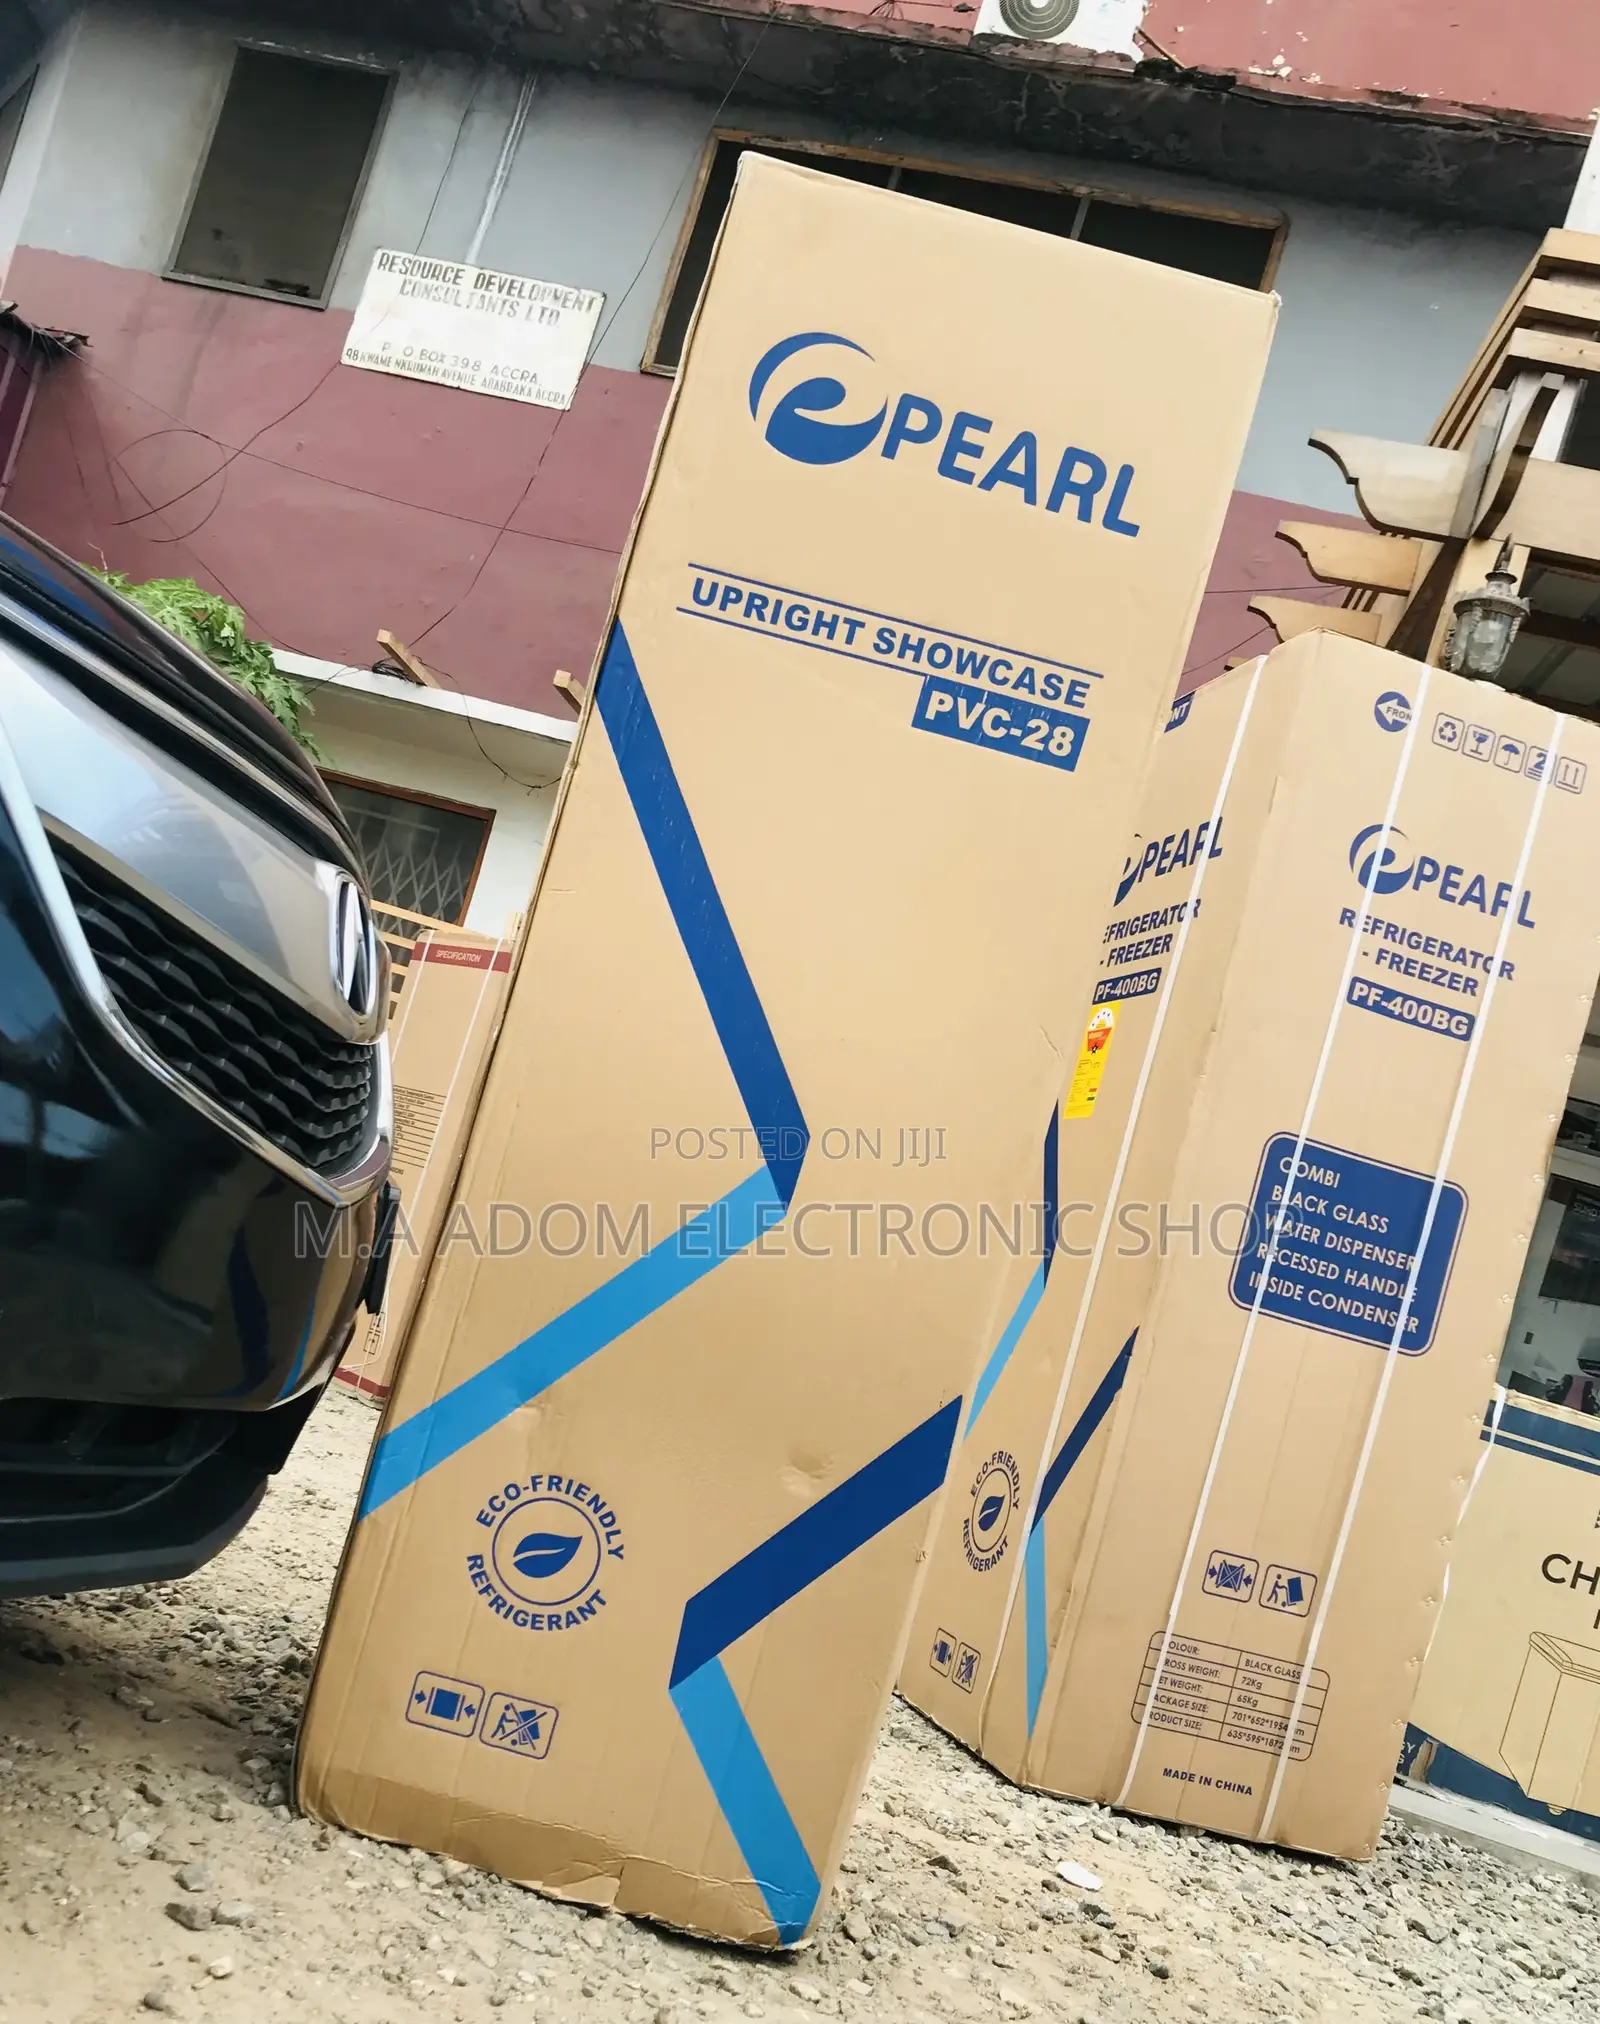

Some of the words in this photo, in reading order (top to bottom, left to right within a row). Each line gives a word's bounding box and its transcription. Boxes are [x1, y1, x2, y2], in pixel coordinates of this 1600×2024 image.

[377, 252, 466, 286] RESOURCE
[473, 272, 597, 314] DEVELOPMENT
[400, 279, 520, 318] CONSULTANTS
[345, 348, 359, 361] 98
[360, 352, 392, 368] KWAME
[441, 368, 476, 386] AVENUE
[535, 388, 566, 405] ACCRA
[450, 351, 481, 372] 398
[881, 393, 1140, 537] PEARL
[692, 577, 866, 645] UPRIGHT
[873, 627, 1091, 708] SHOWCASE
[924, 690, 1075, 757] PVC-28
[1385, 706, 1412, 722] FRON
[1101, 899, 1201, 944] FRIGERATOR
[435, 950, 481, 962] SPECIFICATION
[1106, 933, 1173, 967] FREEZER
[1375, 948, 1479, 996] FREEZER
[1093, 971, 1158, 1001] PF-400BG
[1351, 981, 1469, 1035] PF-400BG
[1279, 1157, 1341, 1188] COMBI
[1271, 1185, 1329, 1217] BACK
[1333, 1205, 1389, 1234] GLASS
[1265, 1213, 1320, 1245] WATER
[1324, 1232, 1417, 1271] DISPENSER
[970, 1450, 1020, 1510] ECO-FRIENDLY
[475, 1474, 624, 1560] ECO-FRIENDLY
[963, 1518, 1009, 1572] REFRIGERANT
[467, 1554, 607, 1631] REFRIGERANT
[1164, 1658, 1186, 1670] ROSS
[1241, 1676, 1263, 1690] 72Kg
[1168, 1641, 1200, 1655] OLOUR:
[1245, 1659, 1272, 1672] BLACK
[1274, 1666, 1301, 1680] GLASS
[1153, 1694, 1190, 1708] ACKAGE
[1232, 1712, 1305, 1736] 7016521954m
[1237, 1695, 1258, 1708] 65Kg
[1149, 1711, 1183, 1725] RODUCT
[1227, 1730, 1300, 1753] 6355951872m
[1163, 1767, 1195, 1782] MADE
[1199, 1776, 1212, 1786] IN
[1215, 1780, 1253, 1796] CHINA
